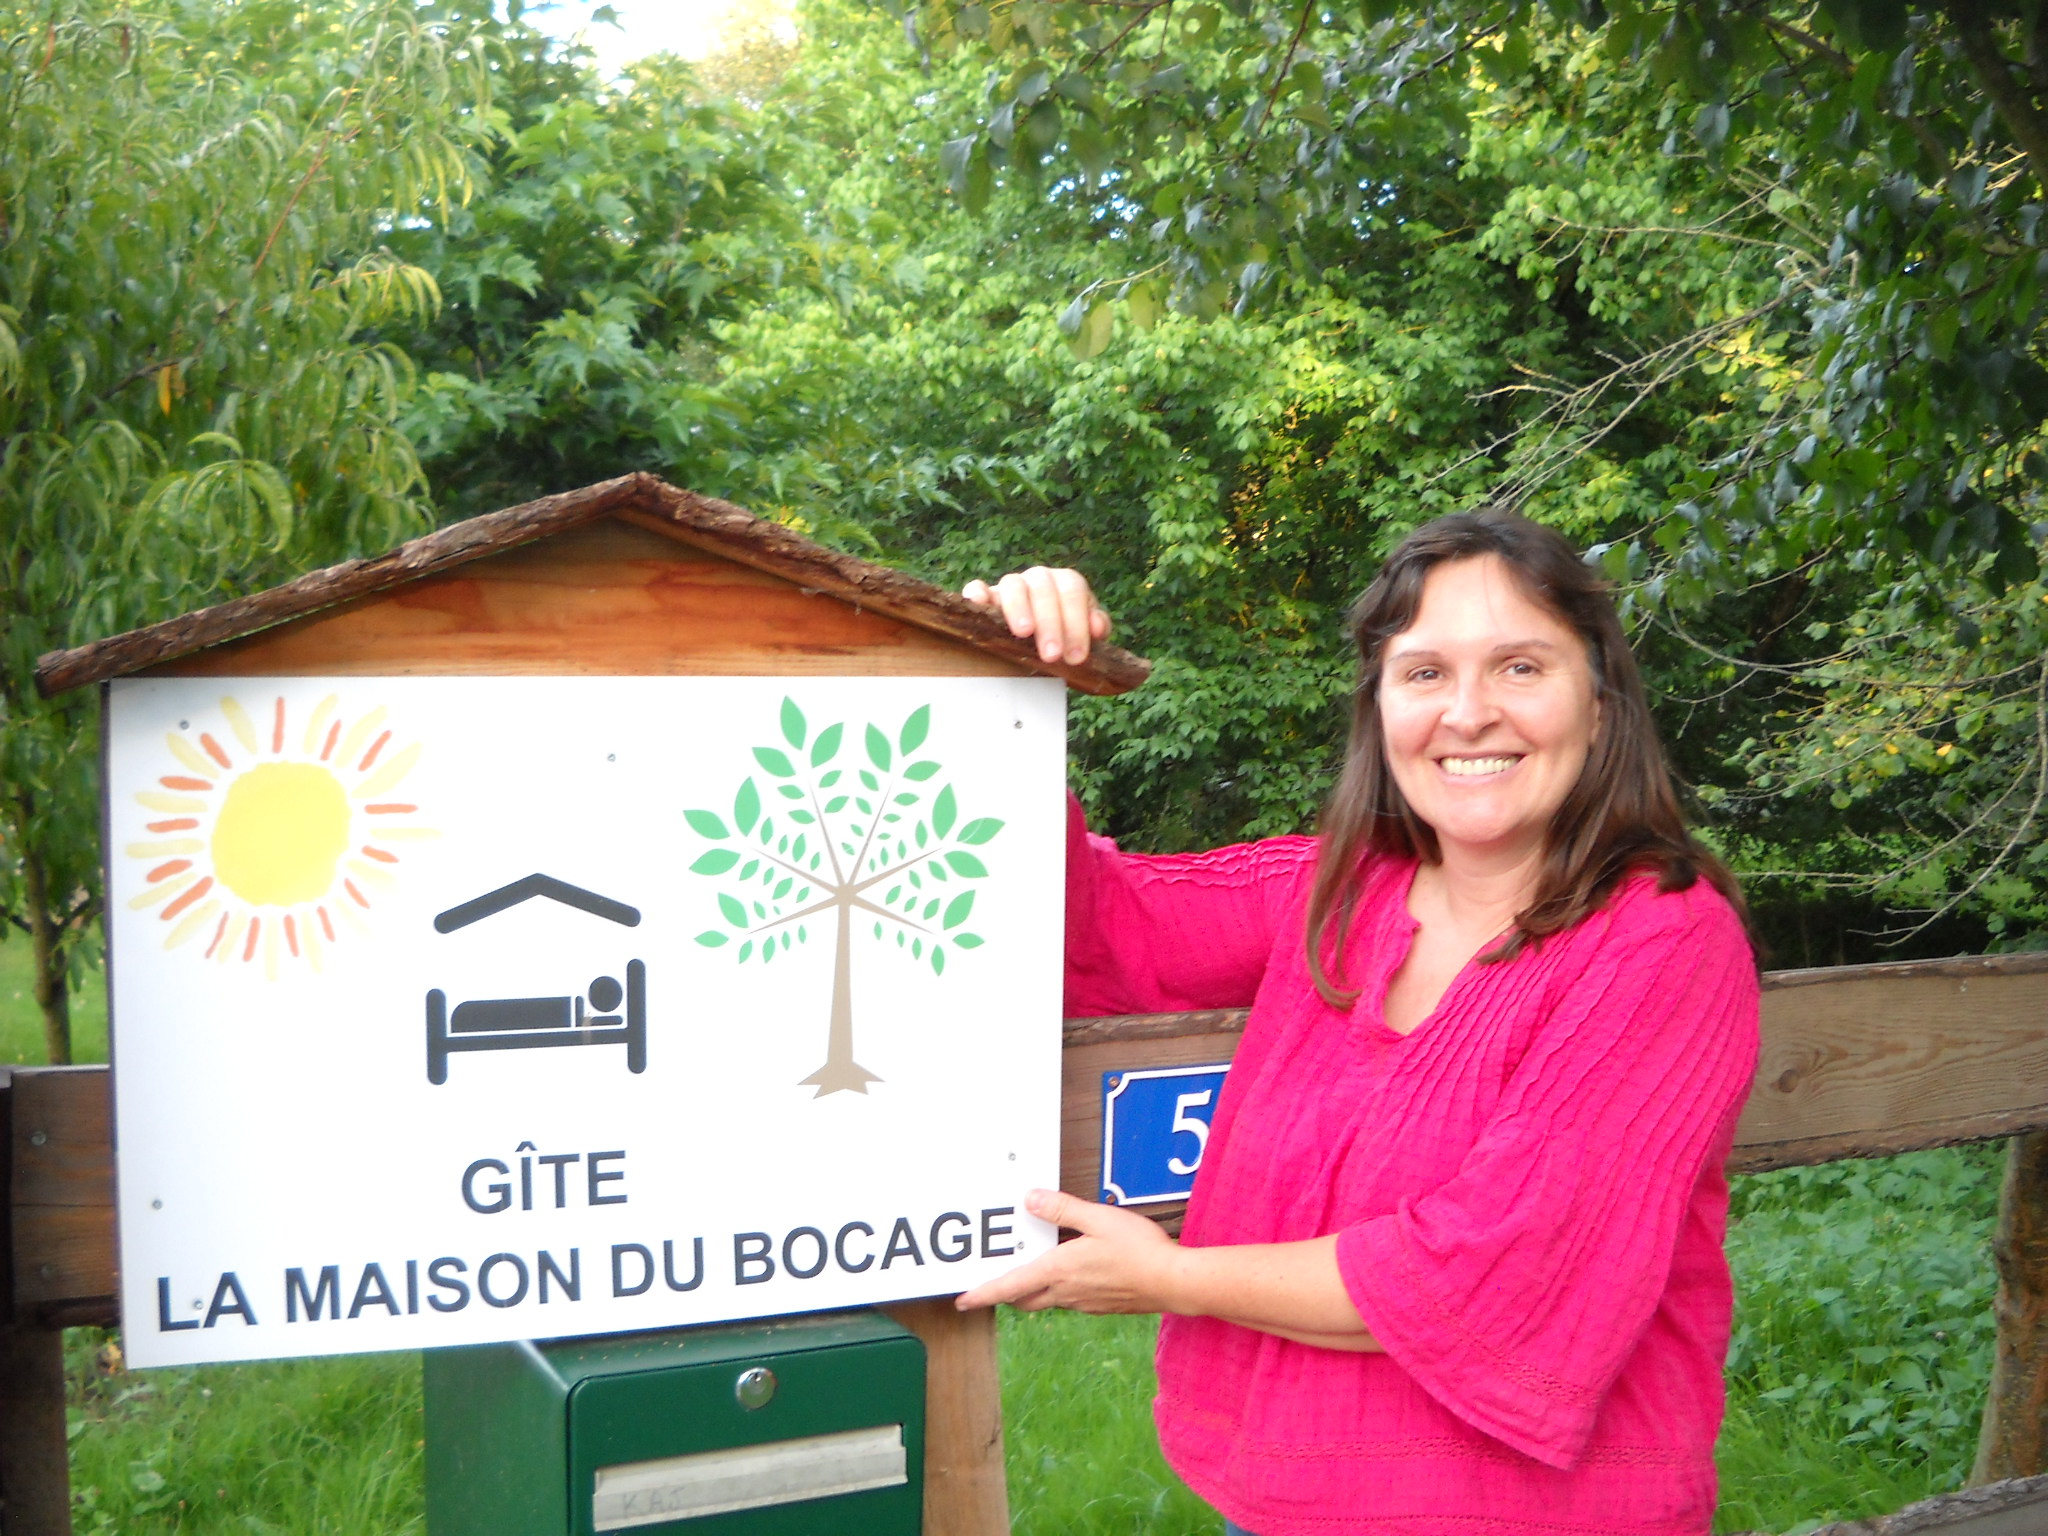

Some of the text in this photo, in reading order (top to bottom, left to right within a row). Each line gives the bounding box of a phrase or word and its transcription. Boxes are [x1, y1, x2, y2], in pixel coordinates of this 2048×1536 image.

[1168, 1089, 1212, 1175] 5
[461, 1141, 628, 1215] GÎTE
[158, 1206, 1015, 1332] LA MAISON DU BOCAGE
